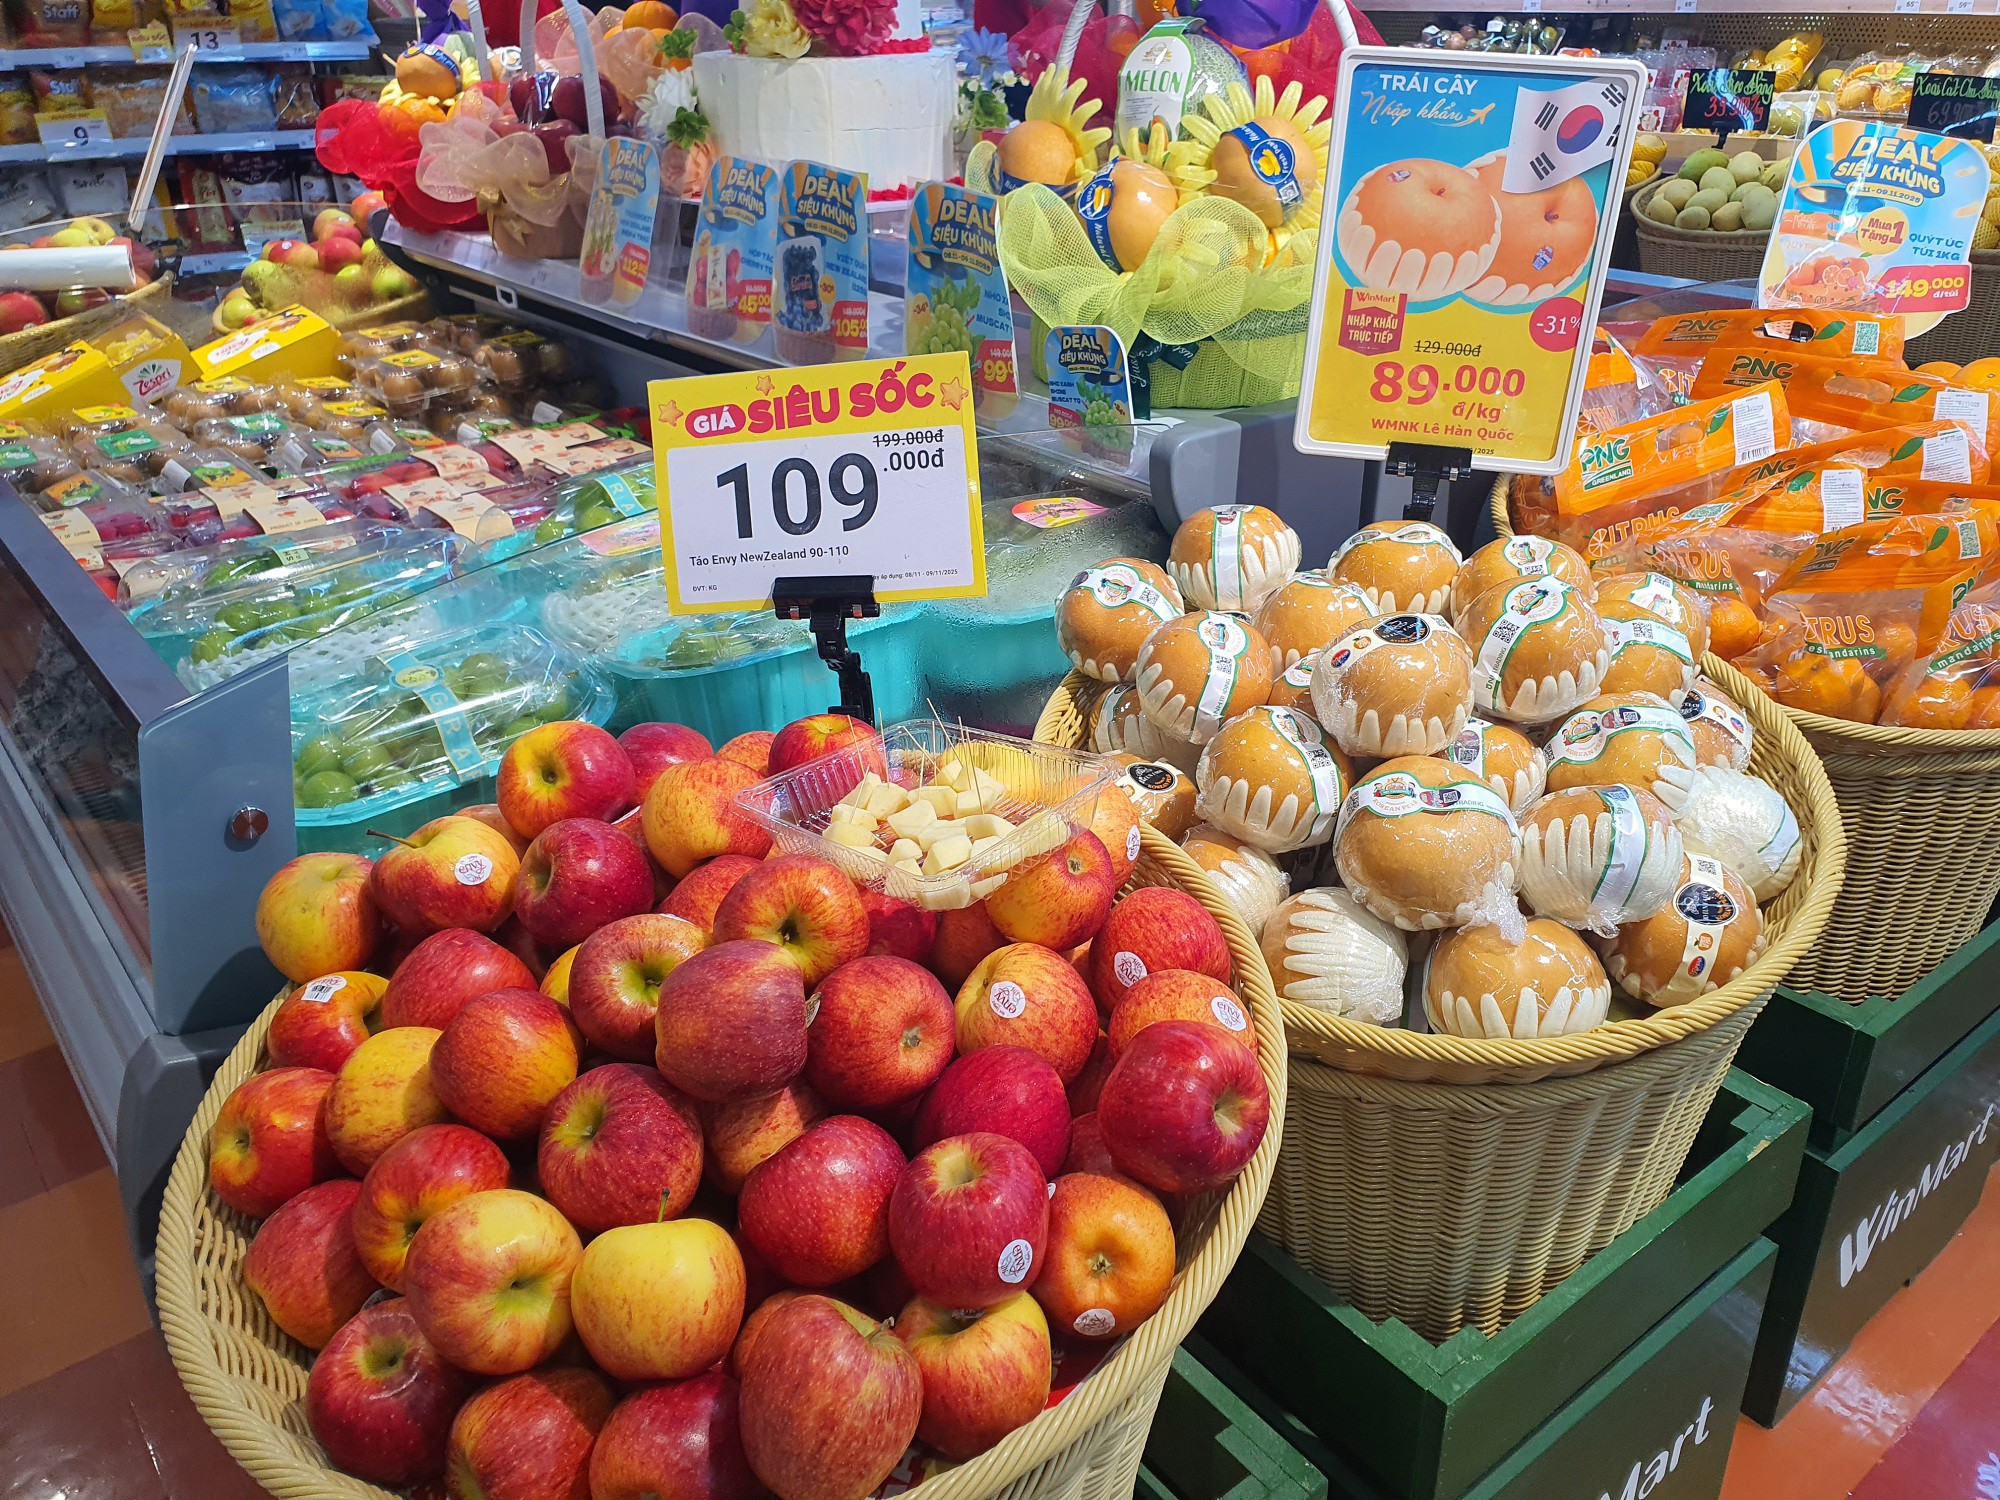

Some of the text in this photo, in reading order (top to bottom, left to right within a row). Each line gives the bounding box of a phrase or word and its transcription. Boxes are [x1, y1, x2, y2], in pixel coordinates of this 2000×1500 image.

[190, 31, 219, 50] 13
[1125, 70, 1183, 93] MELON
[1380, 73, 1478, 96] TRÁI CÂY
[1361, 91, 1464, 127] Nhập khẩu
[617, 150, 643, 170] DEAL
[1279, 153, 1288, 174] Fresh
[1850, 137, 1938, 171] DEAL
[727, 168, 763, 196] DEAL
[1835, 160, 1941, 194] SIÊU KHỦNG
[804, 175, 853, 209] DEAL
[1876, 188, 1921, 203] 09.11.2025
[797, 196, 855, 231] SIÊU KHỦNG
[941, 200, 995, 235] DEAL
[1868, 217, 1892, 231] Mua
[933, 225, 959, 246] SIÊU
[1861, 228, 1890, 245] Tặng
[1890, 221, 1905, 245] 1
[1909, 232, 1964, 249] QUÝT ÚC
[1912, 245, 1960, 261] TÚI 1KG
[1356, 291, 1396, 304] WinMart
[977, 314, 1011, 333] MUSCAT
[1347, 313, 1398, 330] NHẬP KHẨU
[1536, 316, 1581, 335] -31%
[1673, 319, 1728, 332] PNG
[1063, 335, 1100, 350] DEAL
[1349, 327, 1393, 344] TRỰC TIẾP
[1414, 340, 1482, 357] 129.000đ
[1731, 355, 1793, 379] PNG
[133, 367, 173, 397] Zespri
[1370, 360, 1525, 405] 89.000
[693, 361, 935, 434] GIÁ SIÊU SỐC
[1452, 401, 1501, 423] đ/kg
[873, 430, 945, 448] 199.000đ
[1371, 418, 1514, 441] WMNK Lê Hàn Quốc
[1580, 438, 1630, 472] PNG
[1591, 470, 1632, 486] GREENLAND
[1743, 458, 1797, 486] PNG
[717, 447, 945, 539] 109 .000đ
[1867, 487, 1905, 510] NG
[689, 545, 849, 567] Táo Envy NewZealand 90-110
[925, 568, 958, 577] 09/11/2025
[1803, 614, 1875, 646] TRUS
[1829, 646, 1876, 658] andarins
[1937, 628, 2000, 670] mandarins
[1373, 799, 1401, 811] KOREAN
[459, 859, 487, 874] envy
[994, 987, 1017, 1013] envy
[1217, 1001, 1241, 1024] envy
[1839, 1102, 1996, 1289] WinMart
[1010, 1244, 1026, 1277] envy
[1592, 1395, 1715, 1500] Mart
